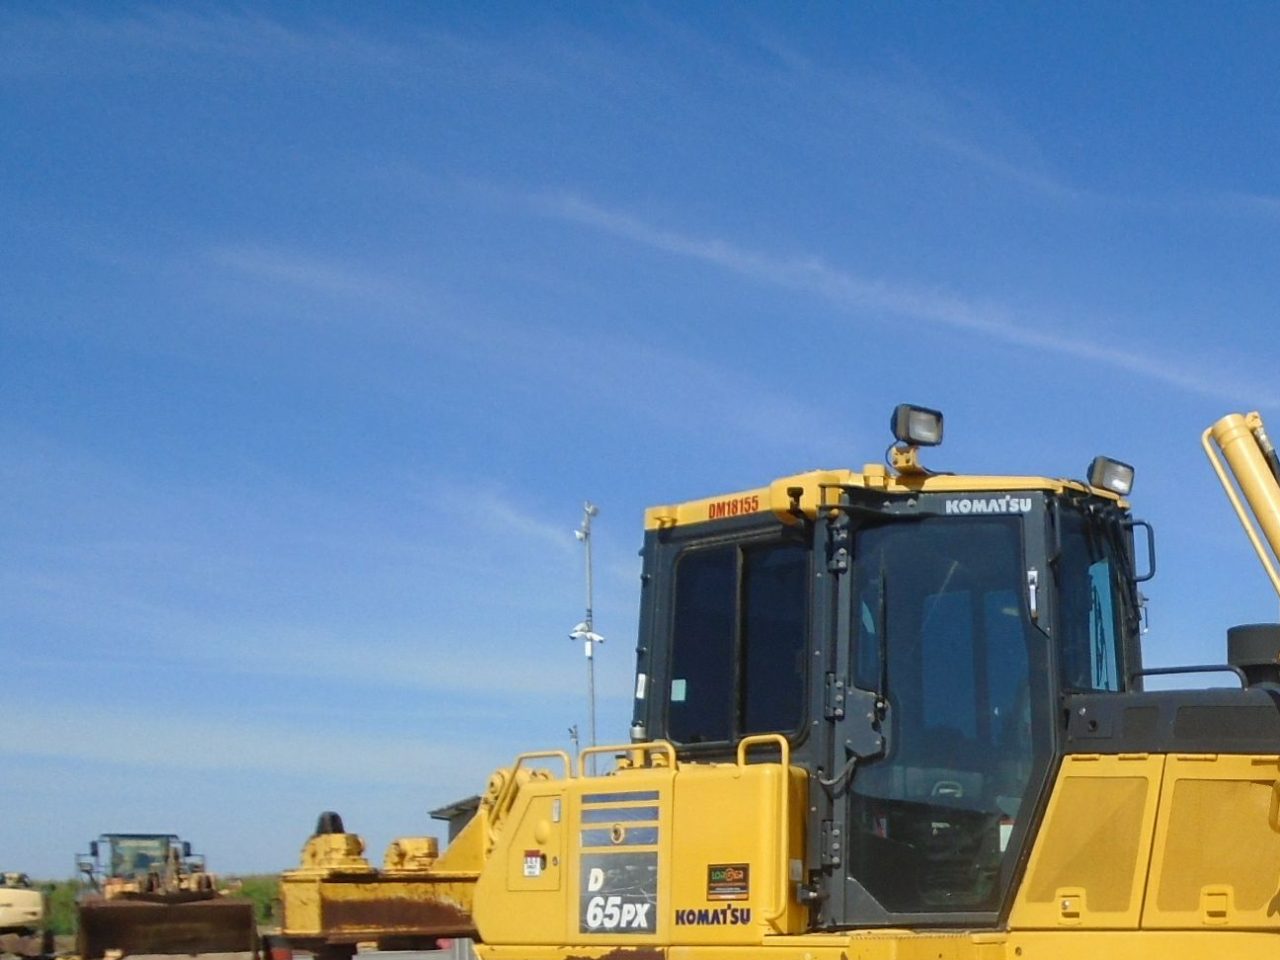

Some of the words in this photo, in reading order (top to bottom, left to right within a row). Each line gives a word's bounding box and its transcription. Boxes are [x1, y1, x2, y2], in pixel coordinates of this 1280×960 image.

[708, 495, 759, 519] DM18155
[945, 494, 1032, 514] KOMATSU
[588, 868, 604, 892] D
[586, 896, 651, 929] 65PX
[675, 903, 751, 926] KOMATSU
